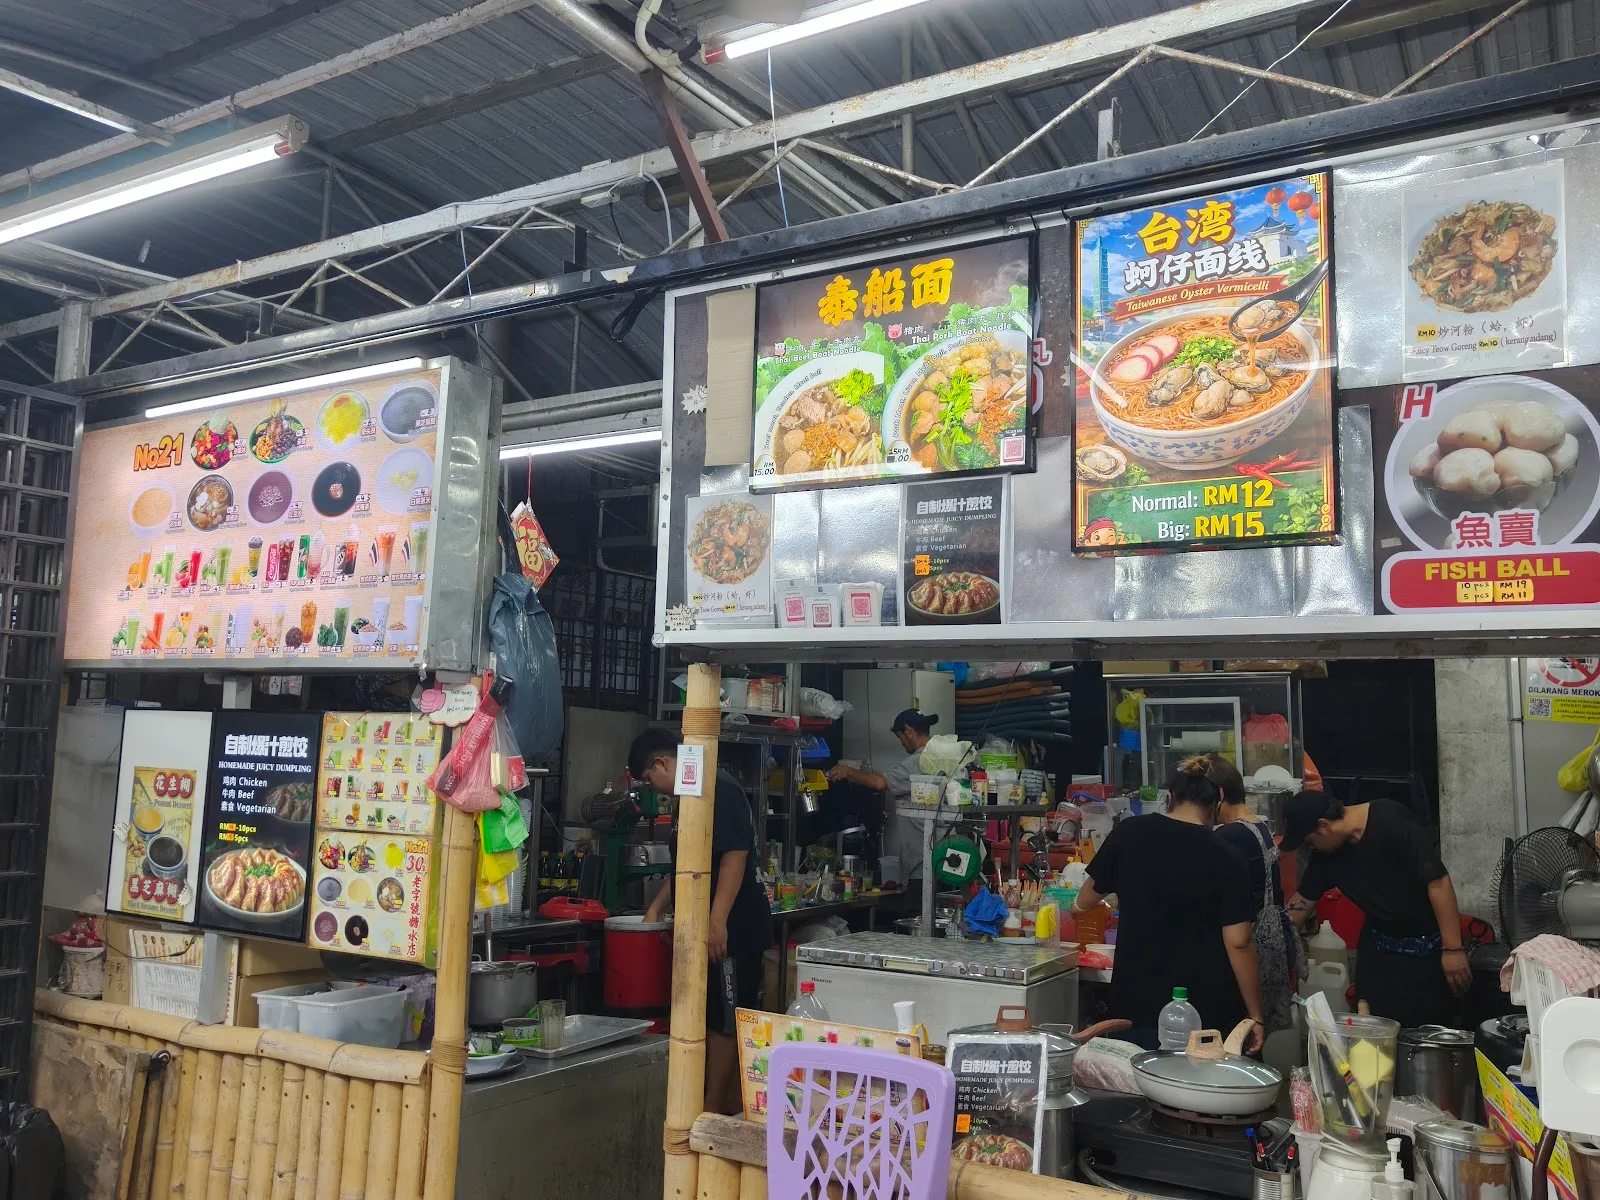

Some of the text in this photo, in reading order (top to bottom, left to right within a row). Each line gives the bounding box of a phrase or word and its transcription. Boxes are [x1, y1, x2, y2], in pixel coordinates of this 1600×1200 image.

[1137, 201, 1236, 257] 台湾
[1123, 240, 1269, 292] 蚵仔面线
[818, 258, 954, 327] 泰船面
[1126, 279, 1269, 313] Taiwanese Oyster Vermicelli
[911, 335, 930, 344] Thai
[933, 331, 953, 341] Pork
[956, 327, 977, 336] Boat
[981, 322, 1011, 334] Noodle
[775, 345, 861, 365] Thai Beef Boat Noodle
[1431, 344, 1449, 353] Teow
[1451, 342, 1477, 352] Goreng
[1402, 386, 1434, 419] H
[133, 432, 185, 472] No21
[754, 467, 775, 477] 15.00
[1131, 492, 1198, 513] Normal:
[1158, 521, 1190, 540] Big:
[1455, 511, 1537, 549] 魚賣
[930, 543, 966, 552] Vegetarian
[1425, 558, 1569, 581] FISH BALL
[1474, 582, 1489, 591] pcs
[1516, 580, 1527, 588] 19
[1474, 593, 1489, 602] pcs
[1528, 686, 1569, 695] DILARANG
[219, 760, 255, 770] HOMEMADE
[255, 762, 274, 771] JUICY
[276, 763, 312, 773] DUMPLING
[239, 777, 267, 787] Chicken
[222, 788, 255, 799] 牛肉 Beef
[172, 800, 192, 809] Dessert
[237, 802, 276, 814] Vegetarian
[971, 1103, 1005, 1111] Vegetarian
